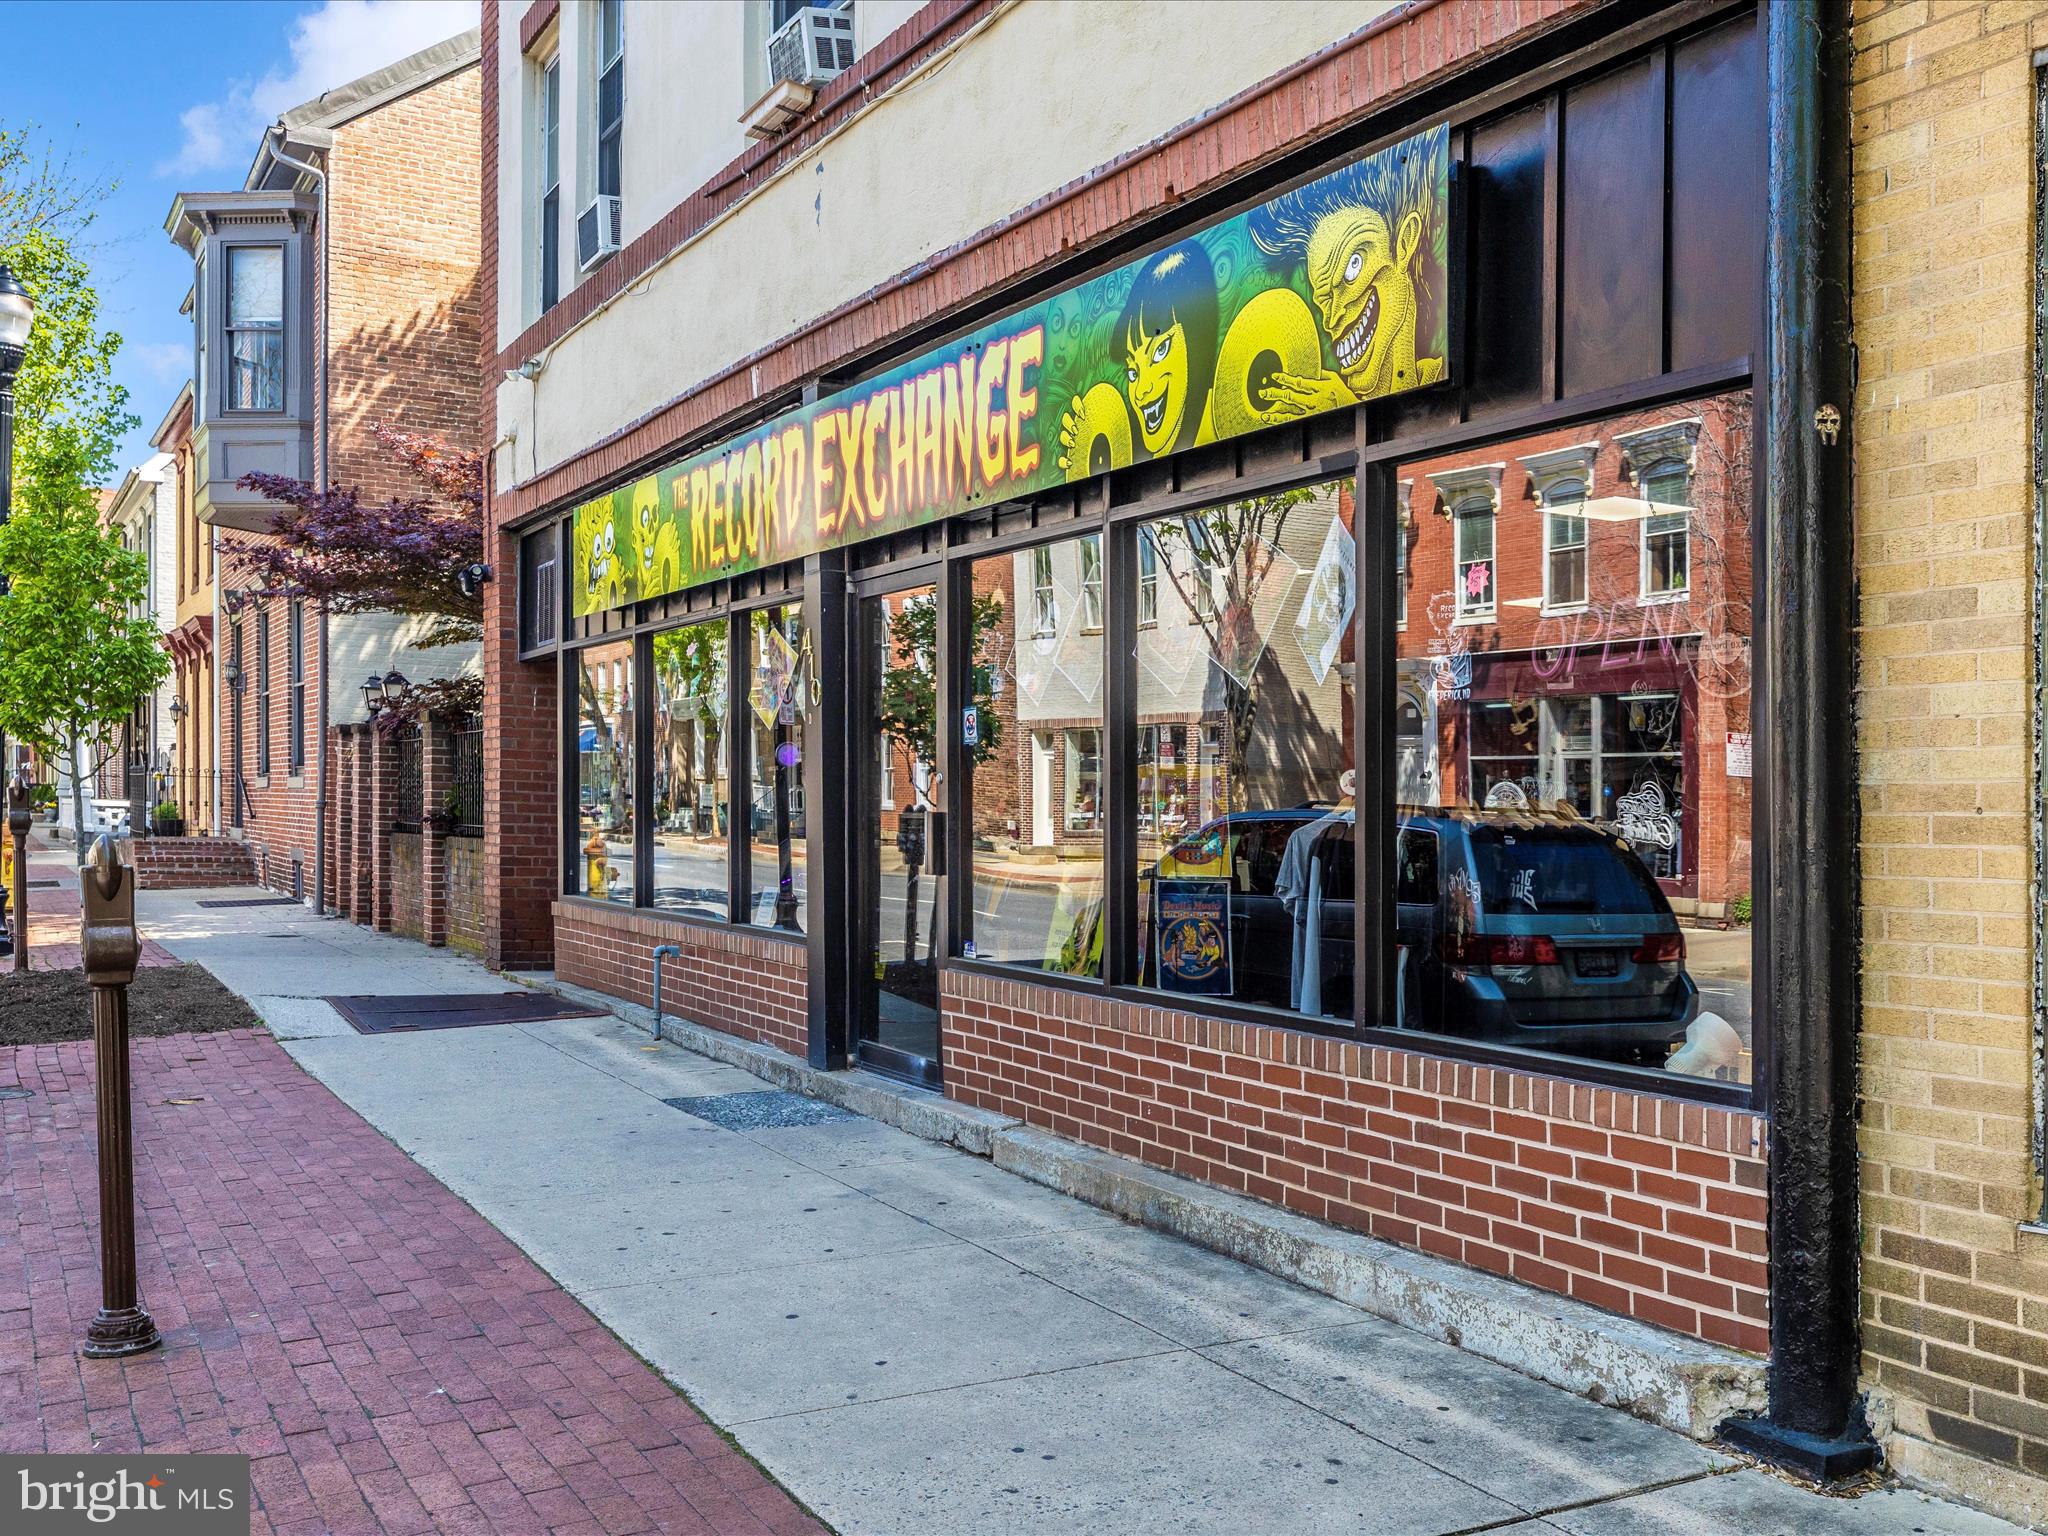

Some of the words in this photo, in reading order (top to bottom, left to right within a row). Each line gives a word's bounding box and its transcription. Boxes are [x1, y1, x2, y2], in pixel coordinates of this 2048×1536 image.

[672, 474, 688, 511] THE
[690, 422, 806, 574] RECORD
[812, 325, 1044, 538] EXCHANGE
[1531, 595, 1680, 678] OPEN
